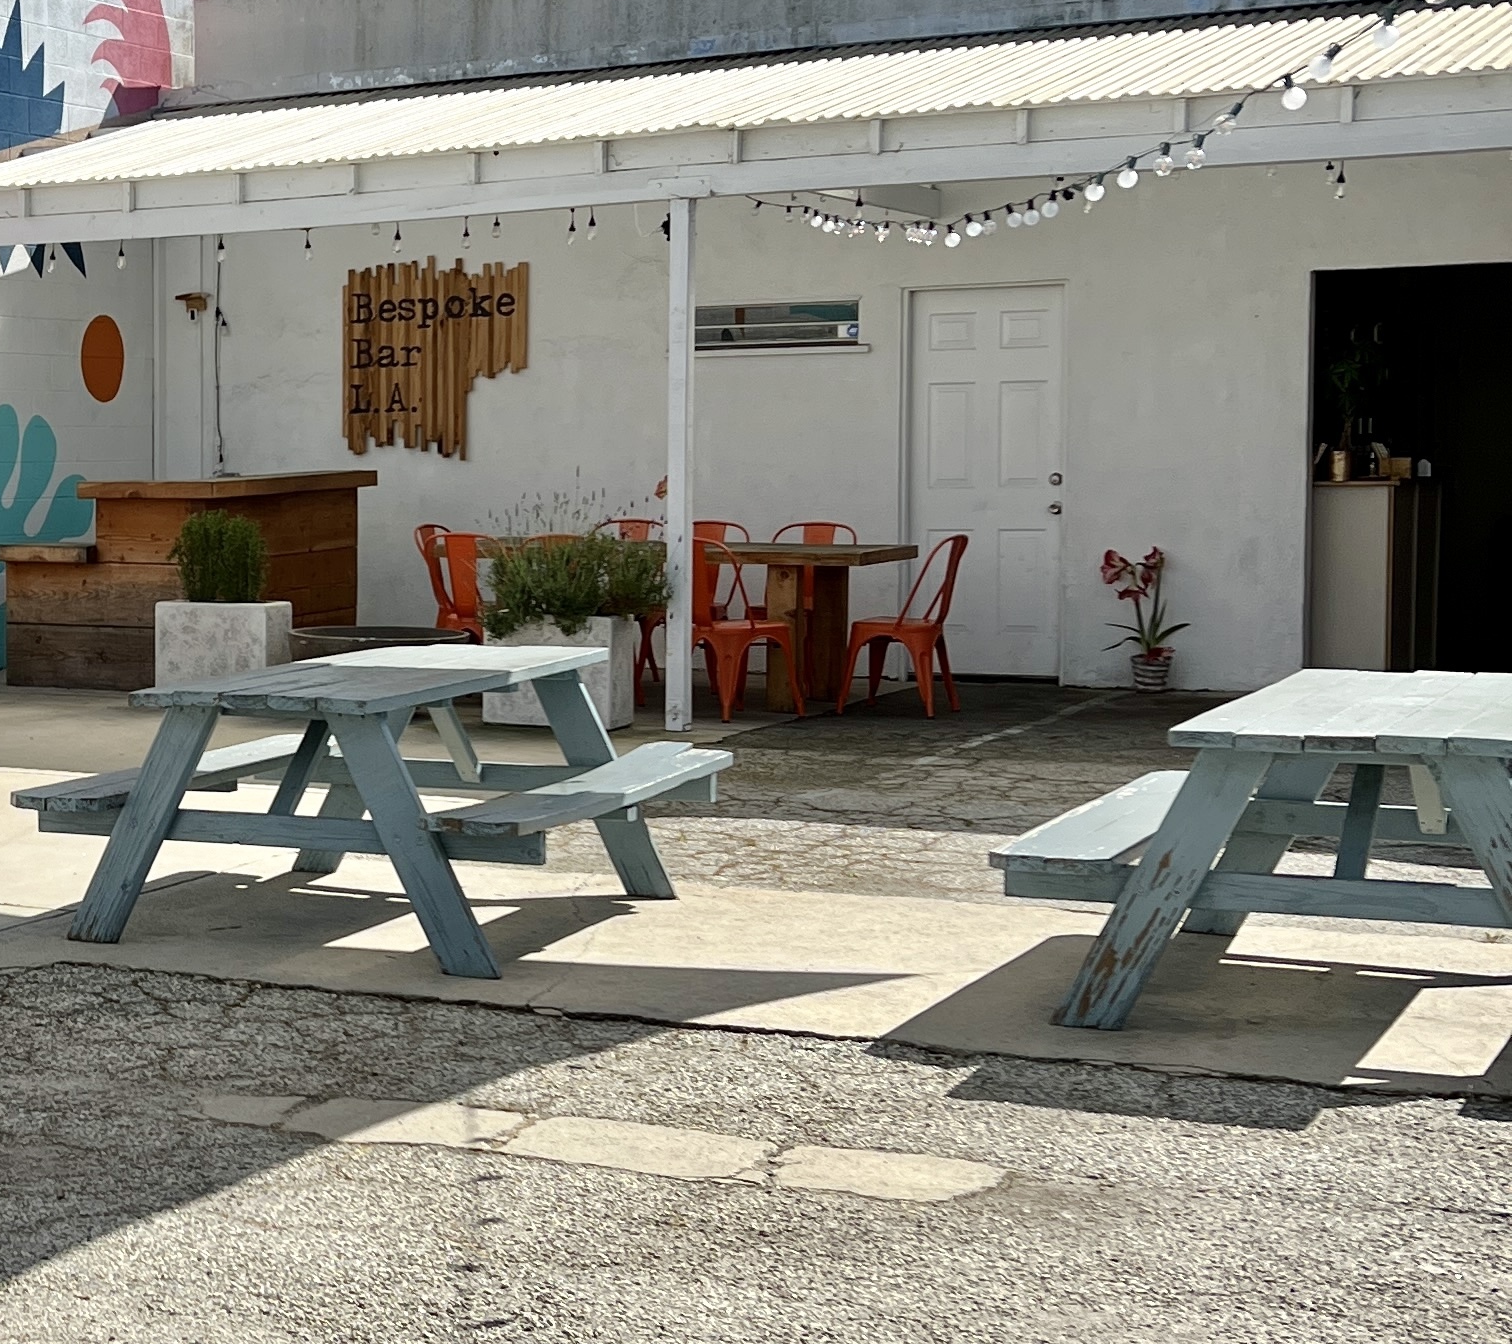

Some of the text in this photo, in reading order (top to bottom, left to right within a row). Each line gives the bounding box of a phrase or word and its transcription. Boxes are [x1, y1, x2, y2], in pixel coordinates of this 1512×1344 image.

[351, 287, 515, 328] Bespoke
[350, 339, 422, 369] Bar
[349, 383, 418, 414] L.A.
